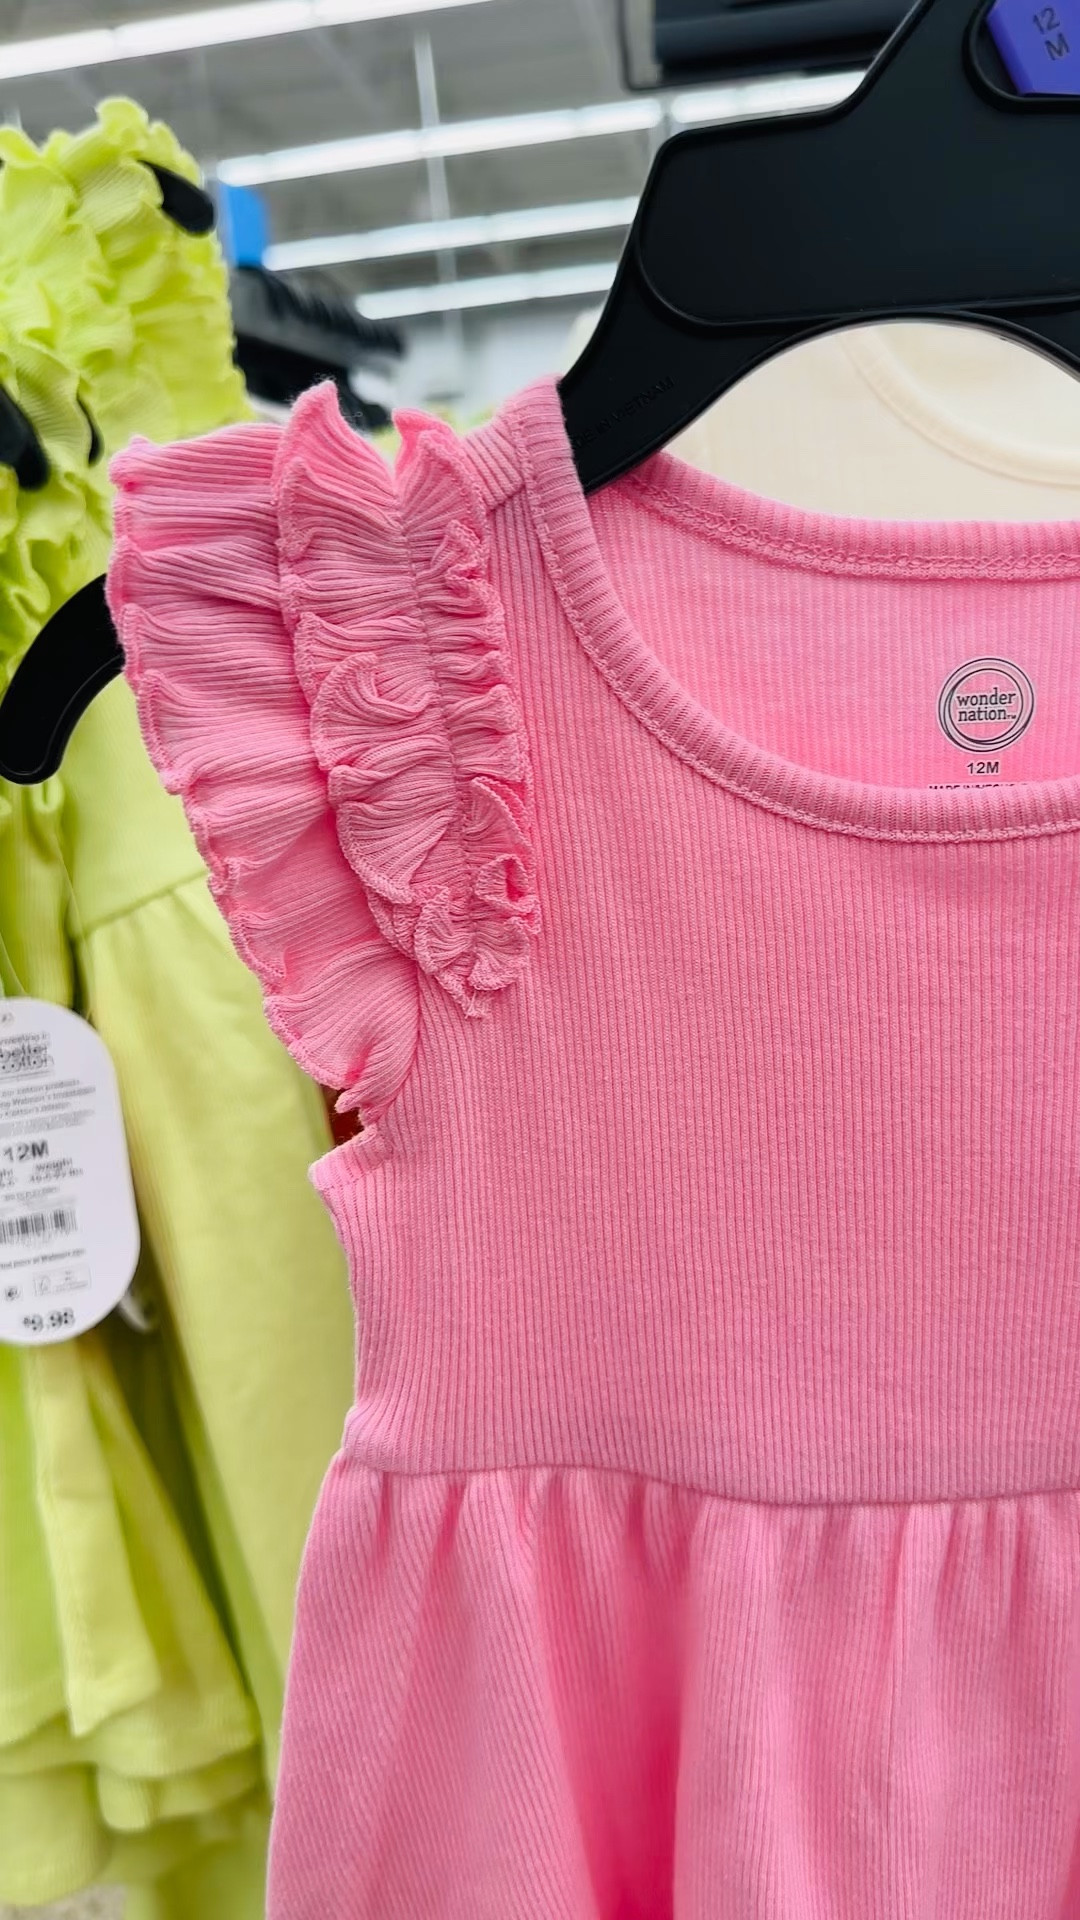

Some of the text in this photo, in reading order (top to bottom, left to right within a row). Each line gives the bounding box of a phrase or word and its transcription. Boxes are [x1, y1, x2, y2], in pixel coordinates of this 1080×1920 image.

[1033, 7, 1060, 35] 12
[1045, 33, 1069, 61] M
[956, 687, 1016, 706] wonder
[967, 761, 999, 774] 12M
[3, 1138, 49, 1162] 12M
